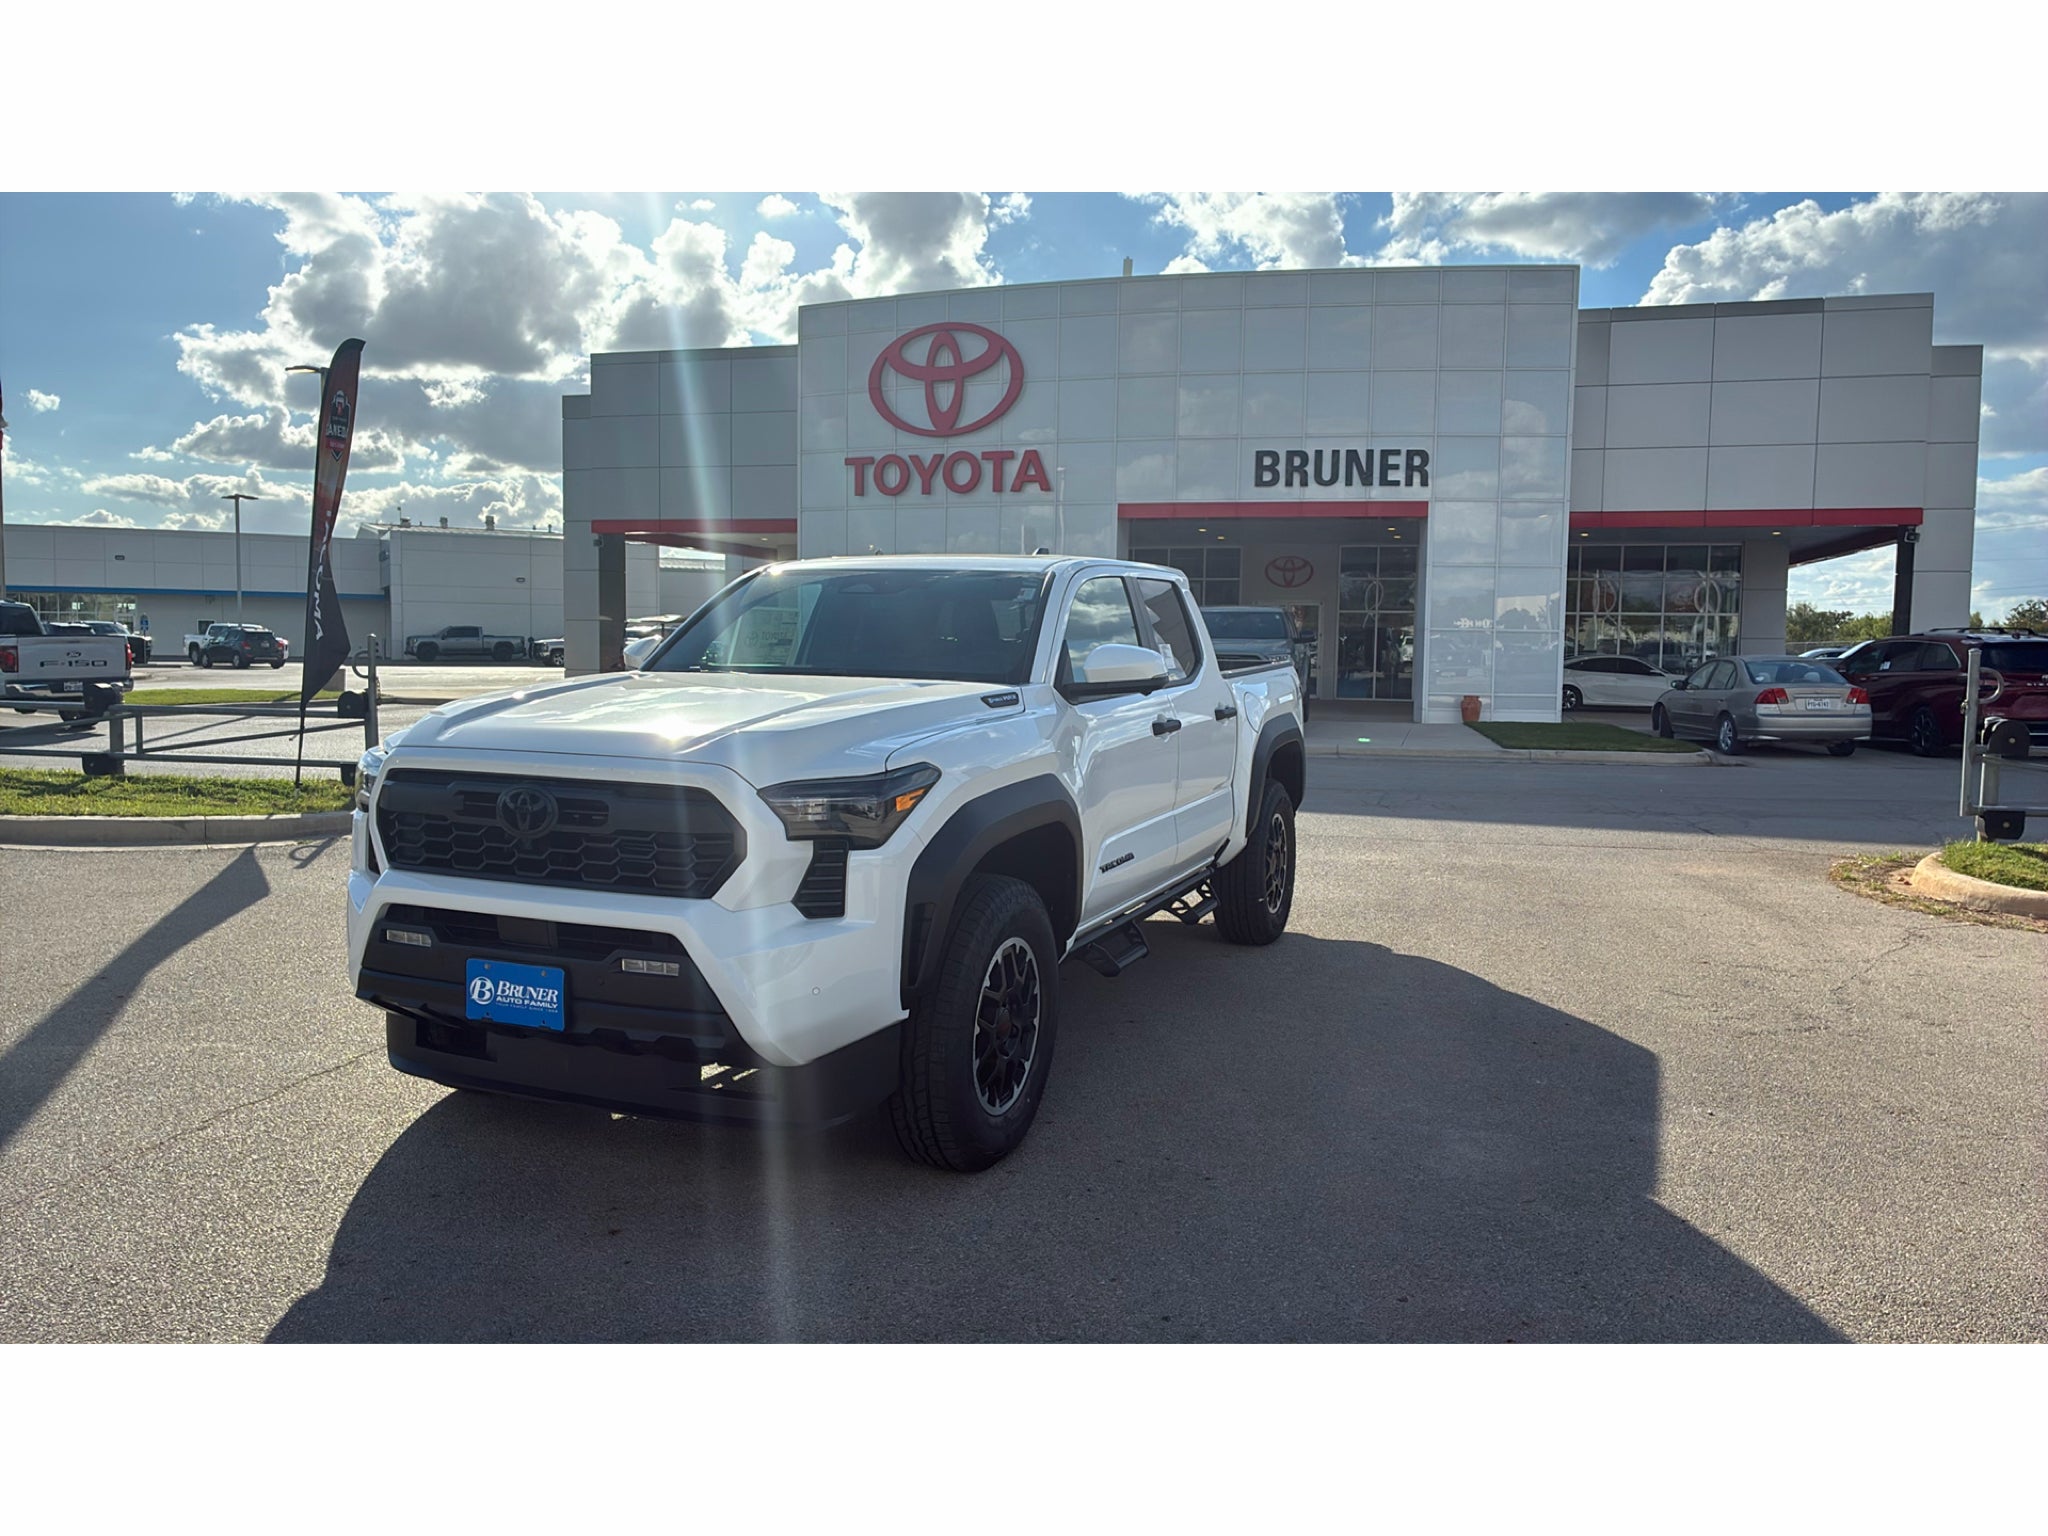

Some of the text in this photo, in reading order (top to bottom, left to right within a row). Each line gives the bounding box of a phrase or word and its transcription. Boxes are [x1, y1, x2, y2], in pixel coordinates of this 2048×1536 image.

[845, 449, 1051, 496] TOYOTA
[1254, 449, 1430, 487] BRUNER
[40, 660, 107, 668] F-150
[496, 980, 559, 1002] BRUNER
[496, 995, 559, 1009] AUTO FAMILY
